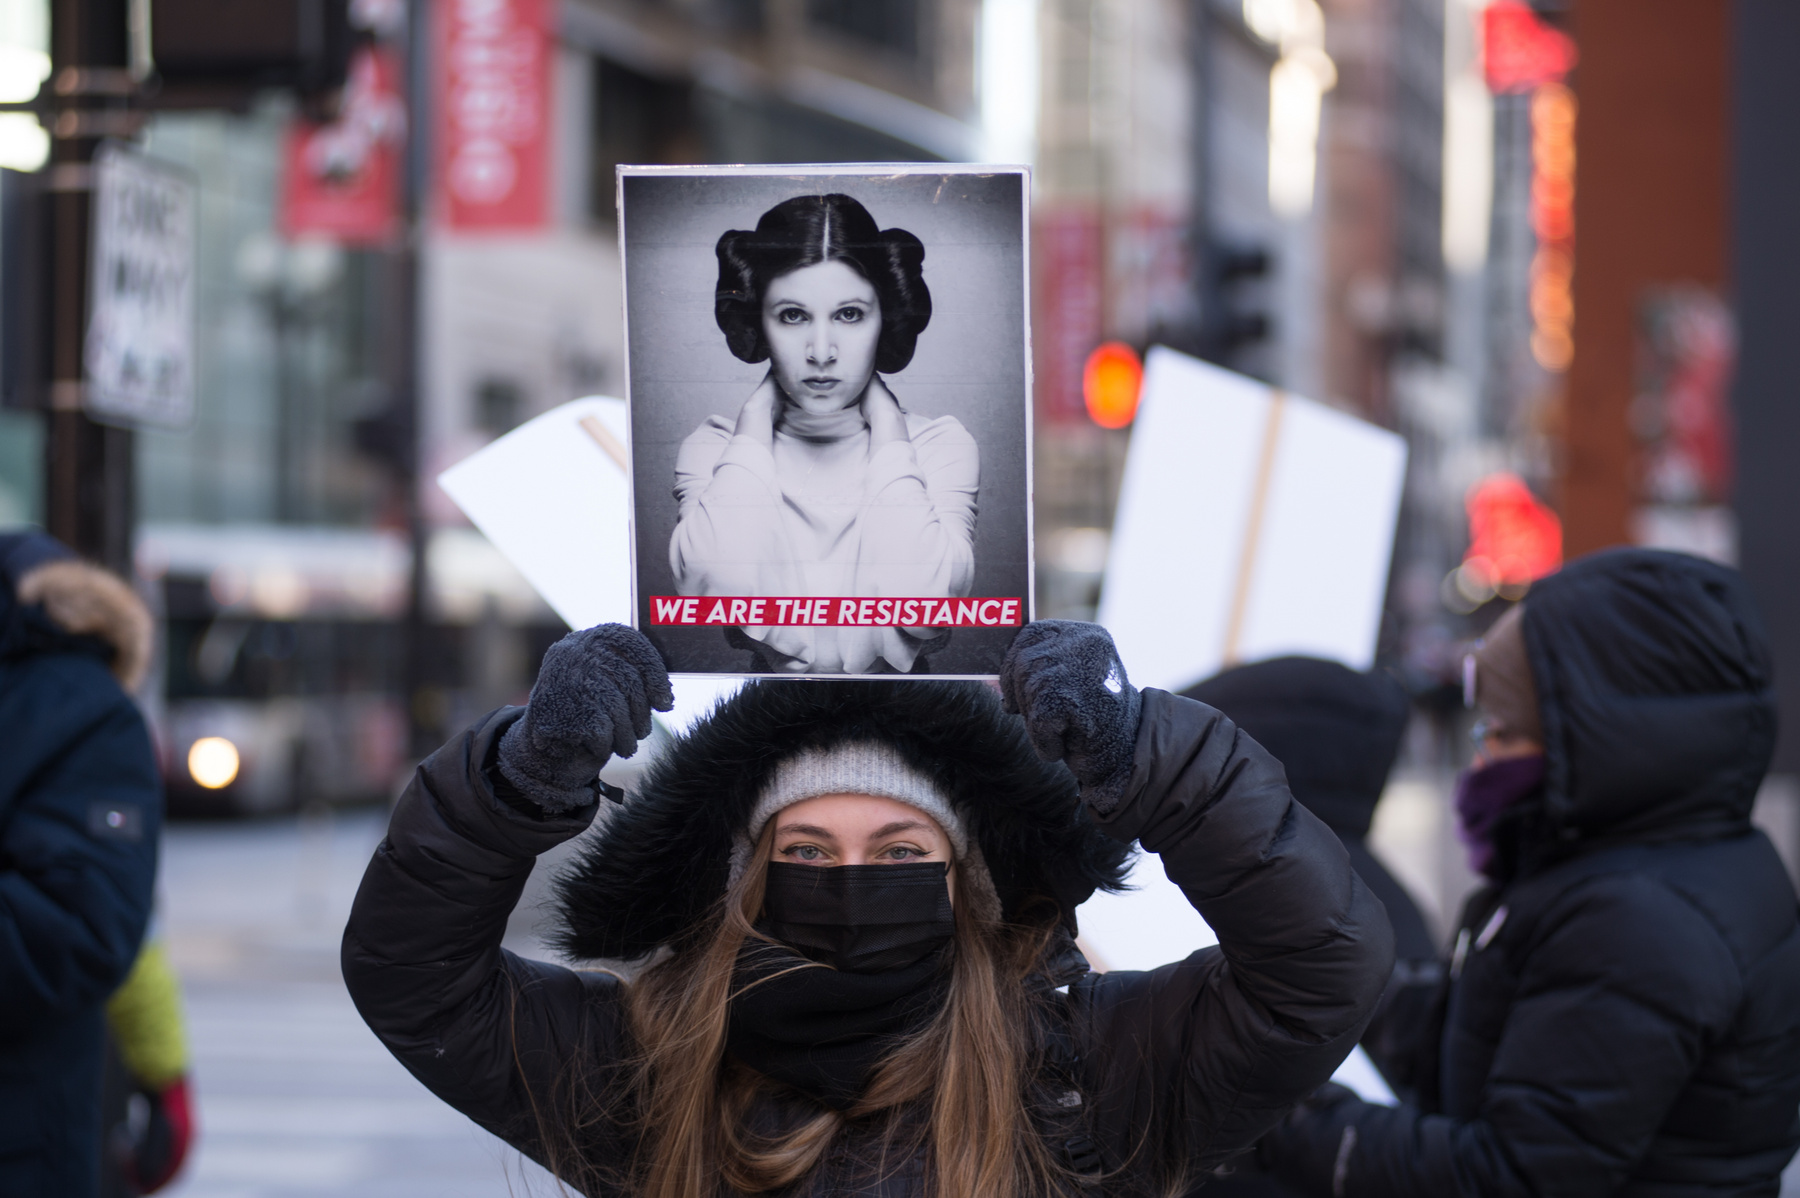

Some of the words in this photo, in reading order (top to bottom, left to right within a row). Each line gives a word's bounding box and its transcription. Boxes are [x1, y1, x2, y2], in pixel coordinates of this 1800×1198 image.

[655, 598, 699, 623] WE
[705, 599, 766, 624] ARE
[776, 599, 830, 624] THE
[837, 599, 1018, 625] RESISTANCE
